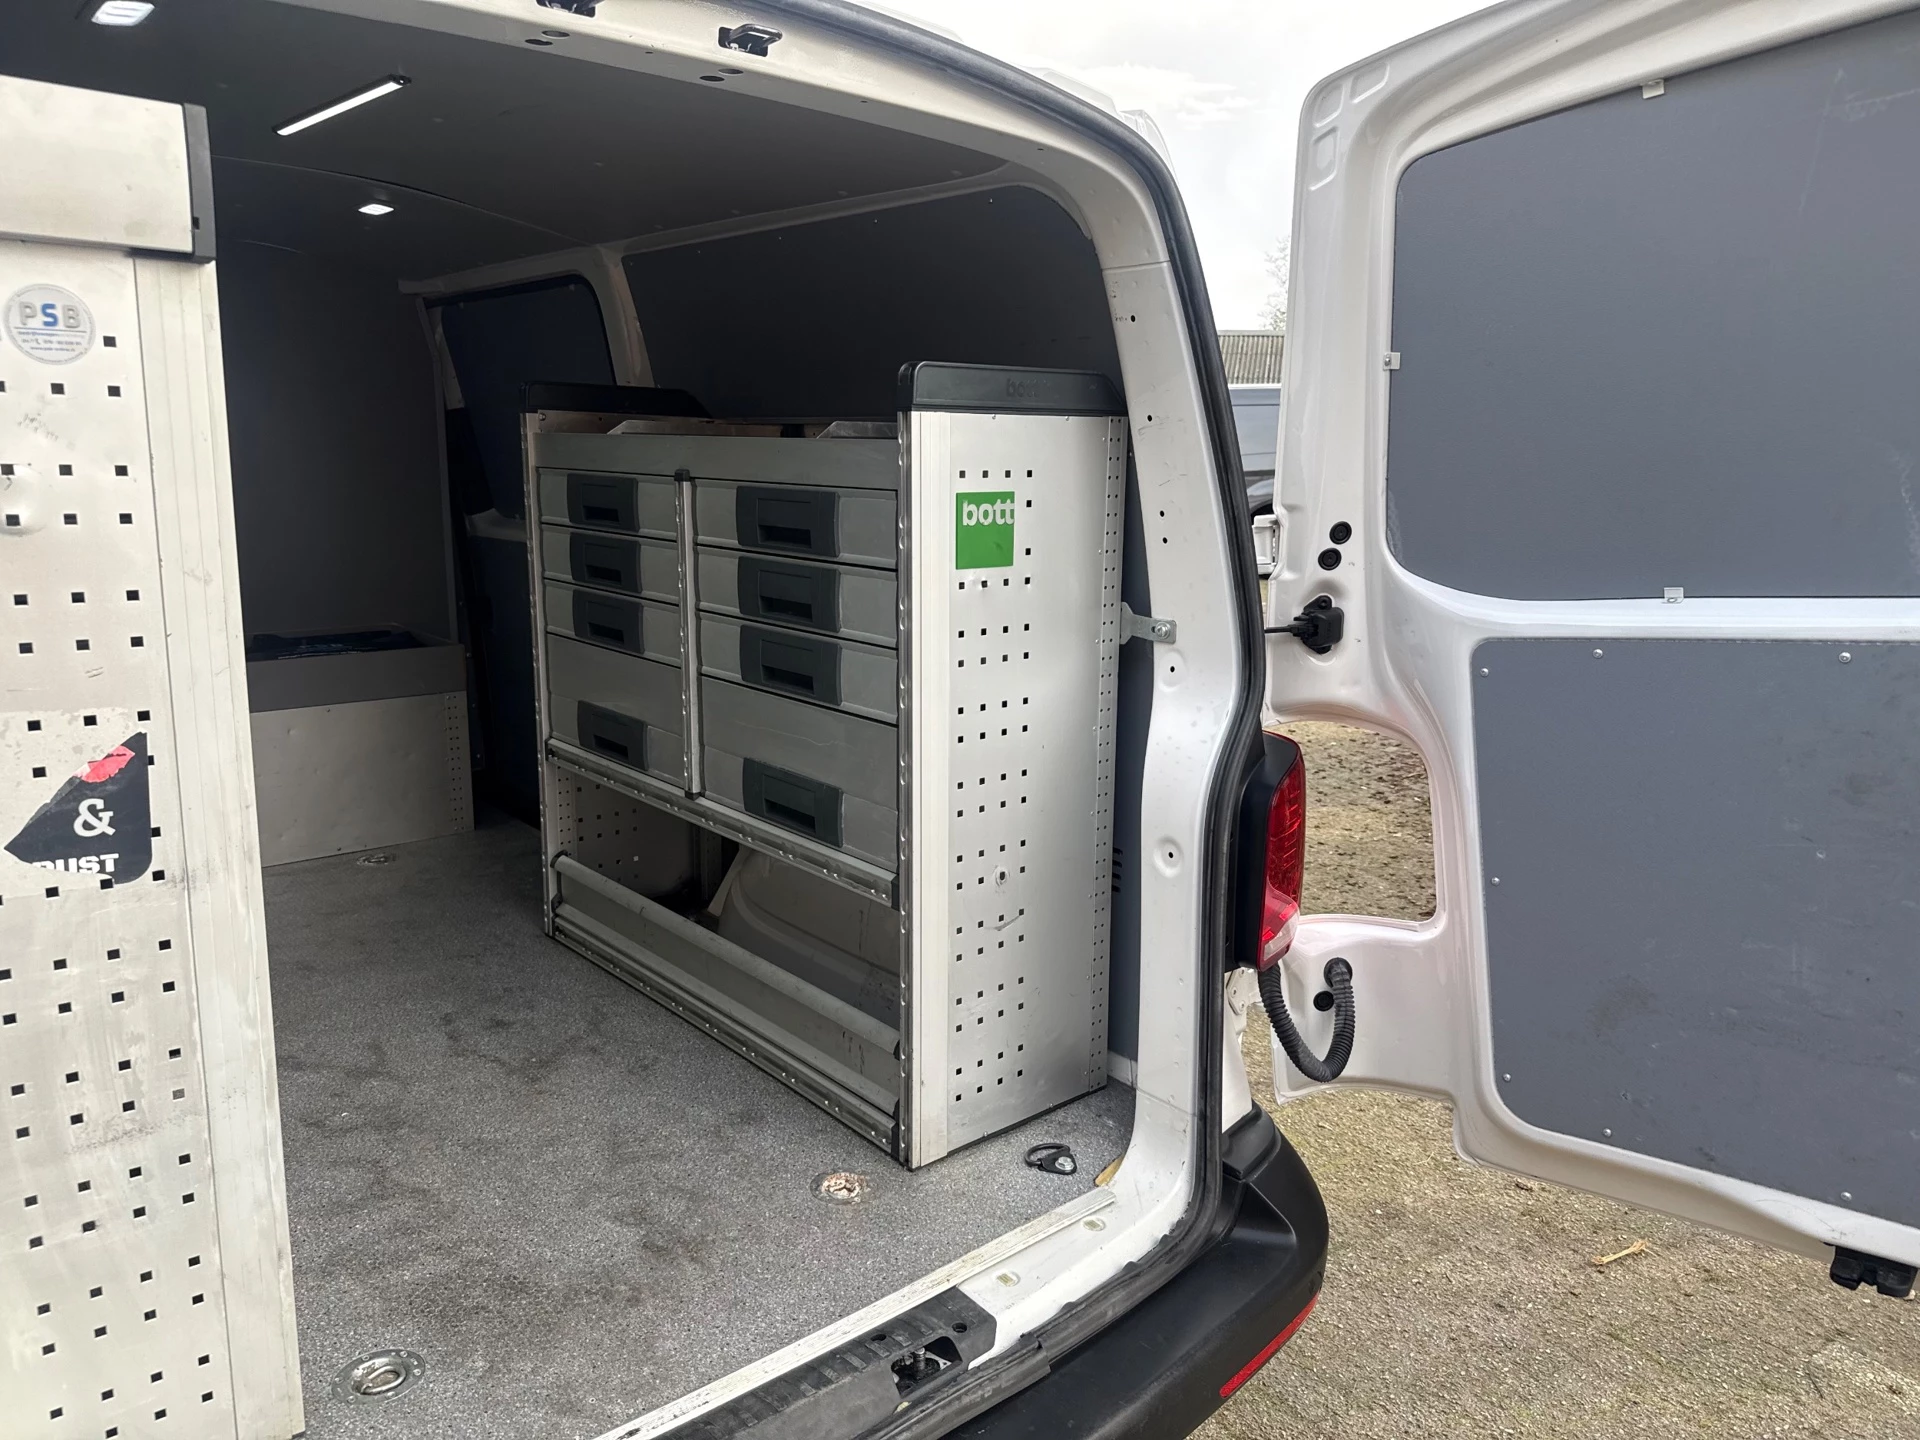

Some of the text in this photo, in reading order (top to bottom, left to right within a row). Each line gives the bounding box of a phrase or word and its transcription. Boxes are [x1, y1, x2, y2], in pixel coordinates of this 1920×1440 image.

[18, 301, 81, 329] PSB
[962, 498, 1015, 526] bott
[73, 798, 116, 837] &
